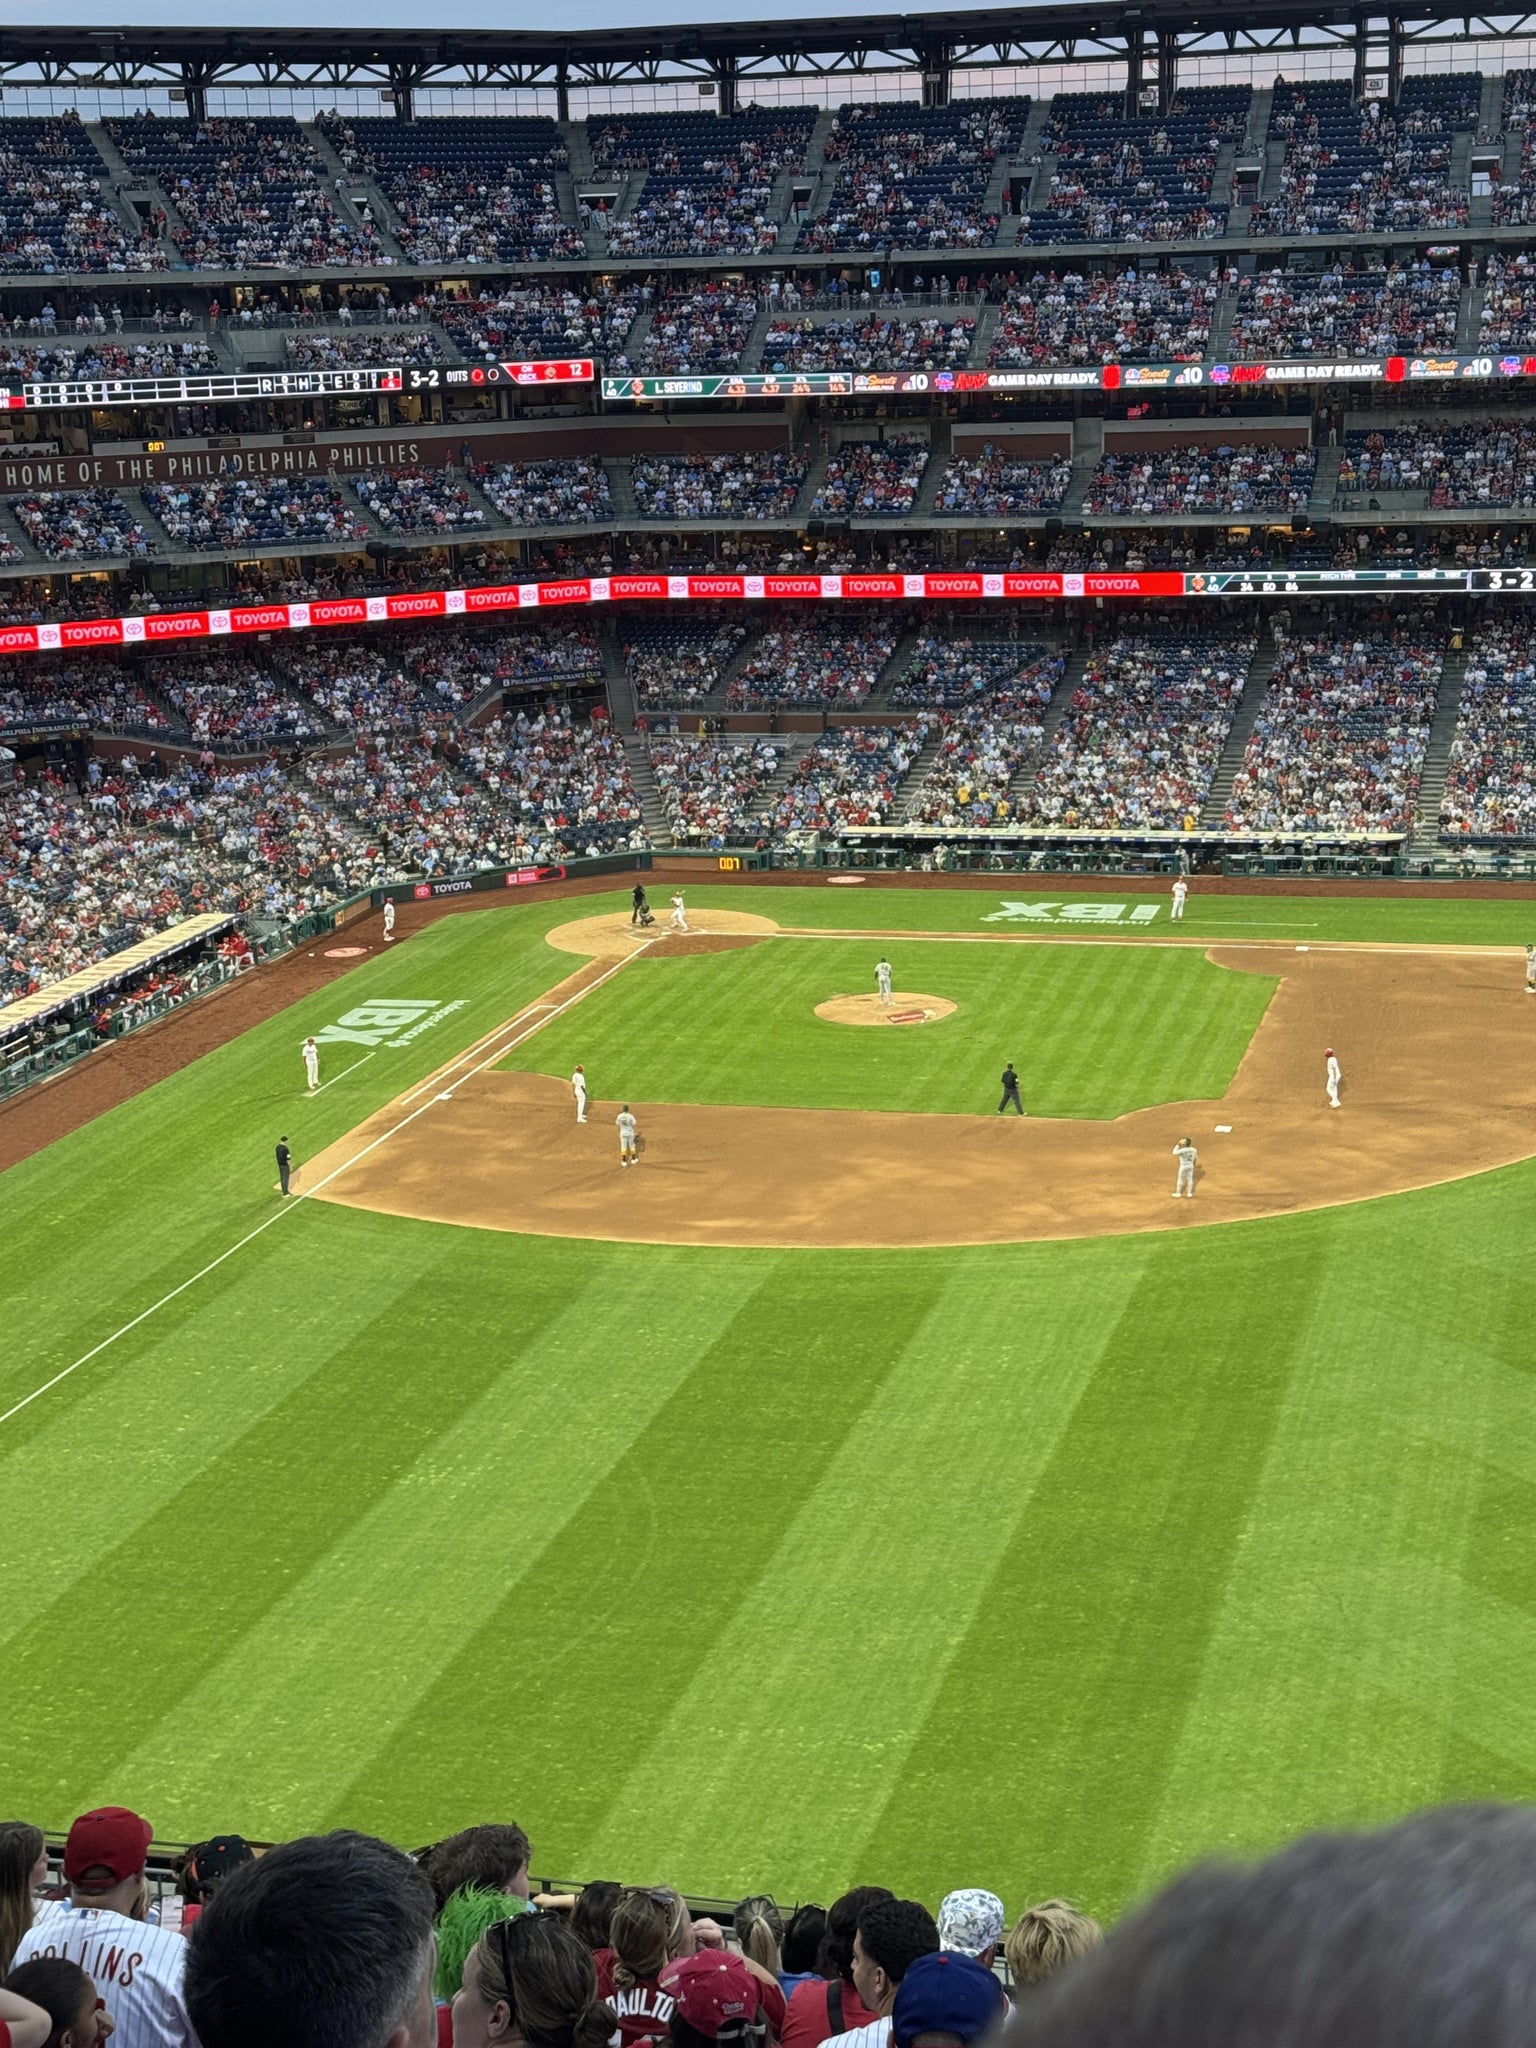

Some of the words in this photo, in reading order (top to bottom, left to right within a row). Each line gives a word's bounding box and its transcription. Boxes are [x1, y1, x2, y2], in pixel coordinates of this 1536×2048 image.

[570, 364, 583, 376] 12
[1265, 367, 1305, 379] GAME
[1306, 366, 1334, 378] DAY
[1334, 364, 1383, 377] READY.
[1472, 358, 1492, 375] 10
[410, 370, 439, 387] 3-2
[447, 371, 468, 382] OUTS
[910, 374, 928, 390] 10
[988, 374, 1026, 386] GAME
[1027, 373, 1053, 385] DAY
[1053, 372, 1099, 385] READY.
[1183, 367, 1202, 383] 10
[263, 380, 272, 392] R
[300, 378, 309, 390] H
[335, 376, 343, 389] E
[6, 464, 66, 486] HOME
[79, 462, 103, 482] OF
[117, 459, 154, 479] THE
[168, 450, 318, 477] PHILADELPHIA
[331, 444, 419, 467] PHILLIES
[613, 581, 661, 594] TOYOTA
[692, 581, 741, 594] TOYOTA
[768, 581, 818, 592] TOYOTA
[846, 580, 897, 592] TOYOTA
[928, 580, 979, 592] TOYOTA
[1008, 579, 1059, 591] TOYOTA
[1088, 578, 1140, 591] TOYOTA
[469, 591, 516, 606] TOYOTA
[541, 585, 588, 599] TOYOTA
[390, 598, 439, 612] TOYOTA
[234, 611, 286, 627] TOYOTA
[313, 605, 363, 621] TOYOTA
[64, 625, 120, 640] TOYOTA
[149, 618, 202, 635] TOYOTA
[719, 857, 740, 870] 007
[433, 881, 472, 894] TOYOTA
[988, 901, 1161, 920] IBX
[300, 1000, 442, 1046] IBX
